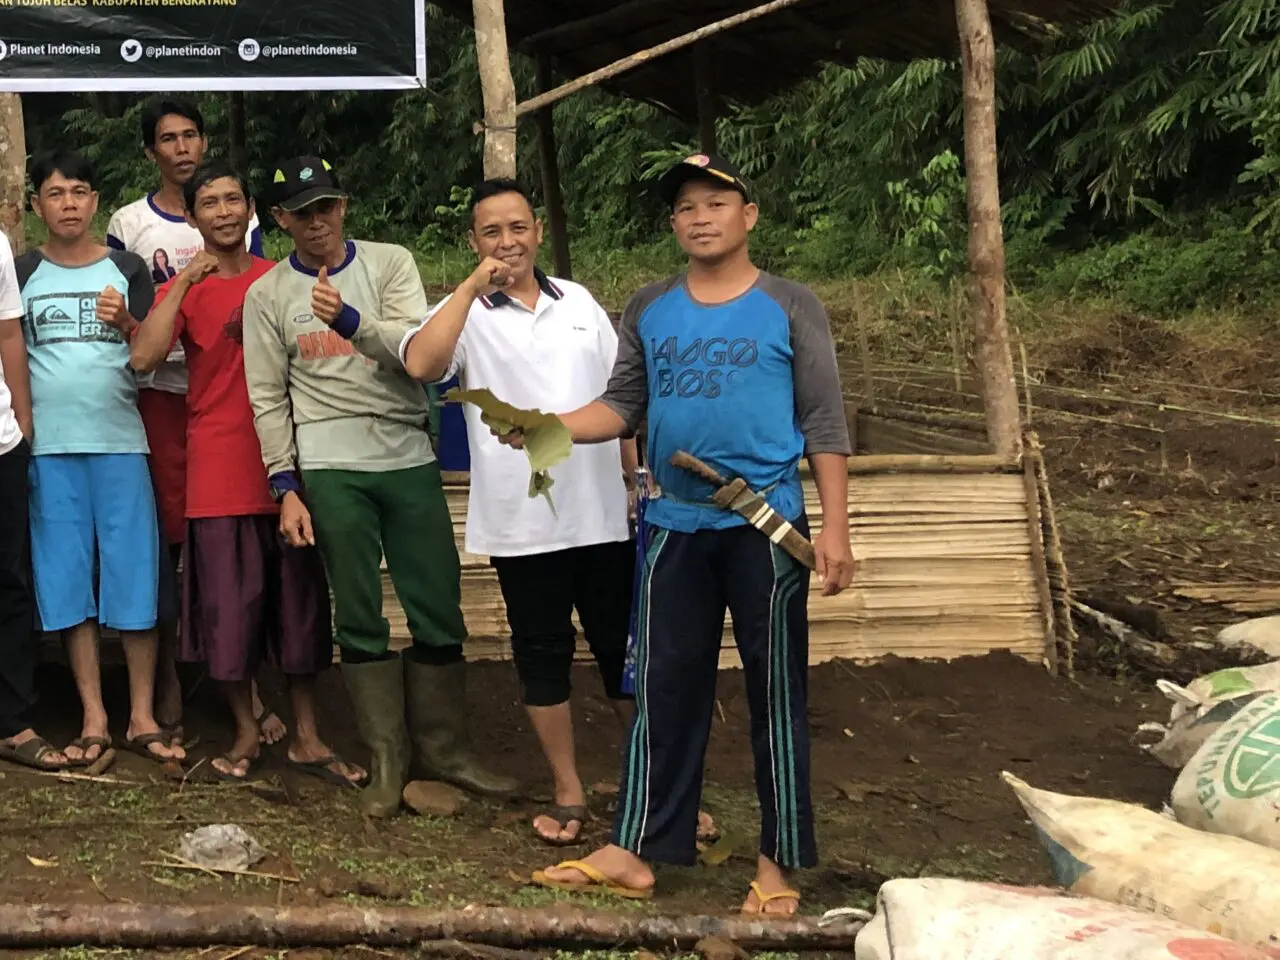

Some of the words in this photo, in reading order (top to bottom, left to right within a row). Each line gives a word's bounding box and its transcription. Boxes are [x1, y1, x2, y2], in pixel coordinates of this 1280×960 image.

[10, 43, 45, 55] Planet
[48, 43, 101, 55] Indonesia
[146, 45, 220, 58] @planetindon
[262, 44, 357, 57] @planetindonesia
